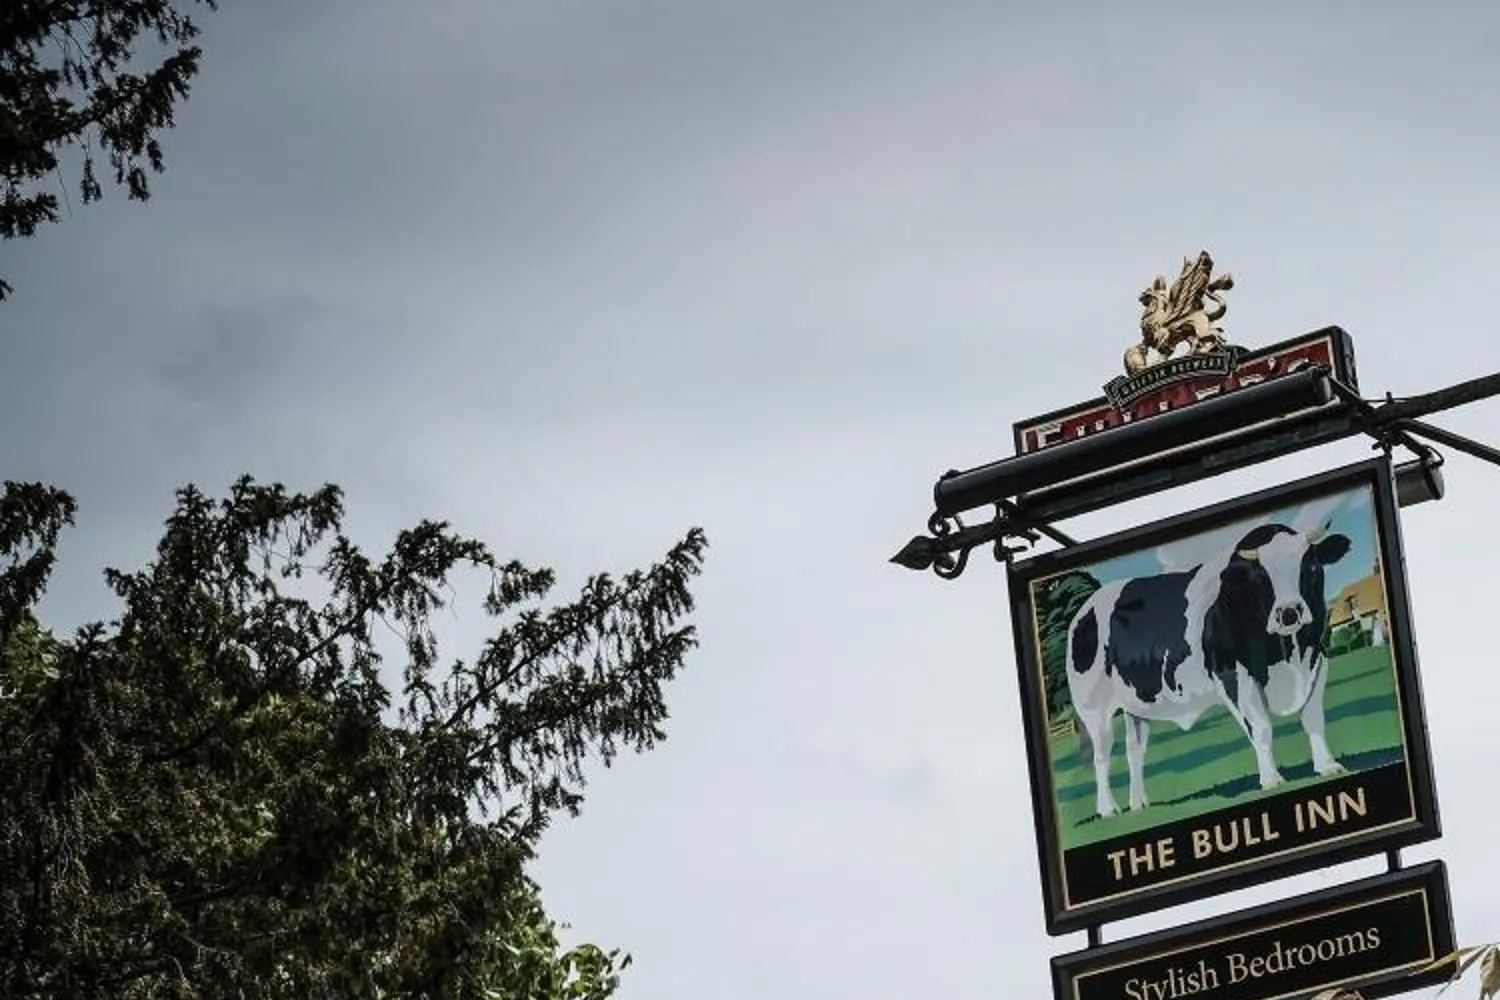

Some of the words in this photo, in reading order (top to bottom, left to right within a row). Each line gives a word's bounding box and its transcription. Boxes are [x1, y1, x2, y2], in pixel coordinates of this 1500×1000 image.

[1107, 836, 1176, 881] THE
[1191, 811, 1280, 860] BULL
[1294, 786, 1368, 833] INN
[1226, 926, 1381, 986] Bedrooms
